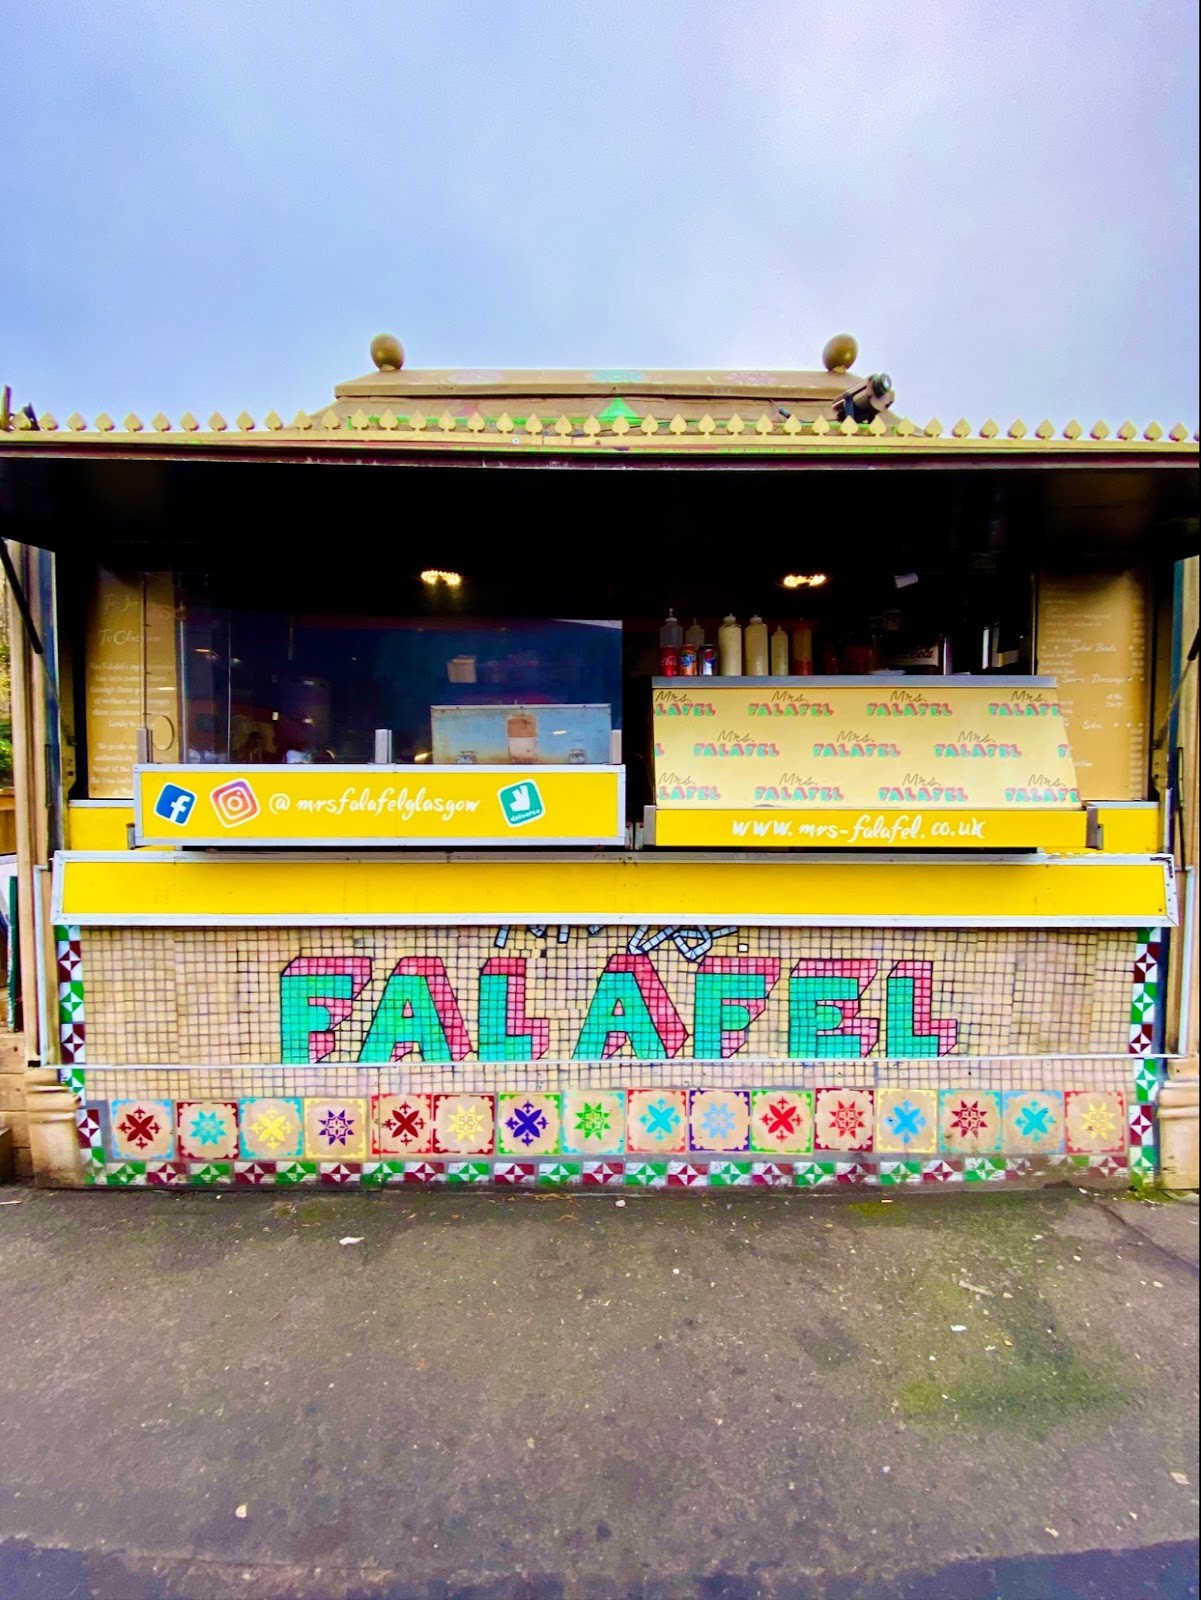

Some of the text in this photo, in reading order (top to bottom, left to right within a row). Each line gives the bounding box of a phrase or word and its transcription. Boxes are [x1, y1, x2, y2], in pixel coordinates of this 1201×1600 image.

[655, 691, 692, 702] Mrs.
[771, 691, 808, 702] Mrs.
[890, 690, 927, 702] Mrs.
[1011, 690, 1048, 702] Mrs.
[653, 703, 716, 717] LAFEL
[747, 703, 834, 717] FALAFEL
[866, 703, 953, 717] FALAFEL
[717, 730, 754, 742] Mrs.
[837, 730, 875, 742] Mrs.
[957, 730, 995, 743] Mrs.
[693, 743, 780, 757] FALAFEL
[813, 743, 901, 758] FALAFEL
[934, 743, 1022, 758] FALAFEL
[658, 772, 696, 786] Mrs.
[779, 773, 817, 786] Mrs.
[903, 773, 941, 787] Mrs.
[1028, 774, 1066, 787] Mrs.
[656, 786, 721, 801] LAFEL
[754, 786, 844, 801] FALAFEL
[878, 787, 968, 802] FALAFEL
[280, 953, 957, 1064] FALAFEL
